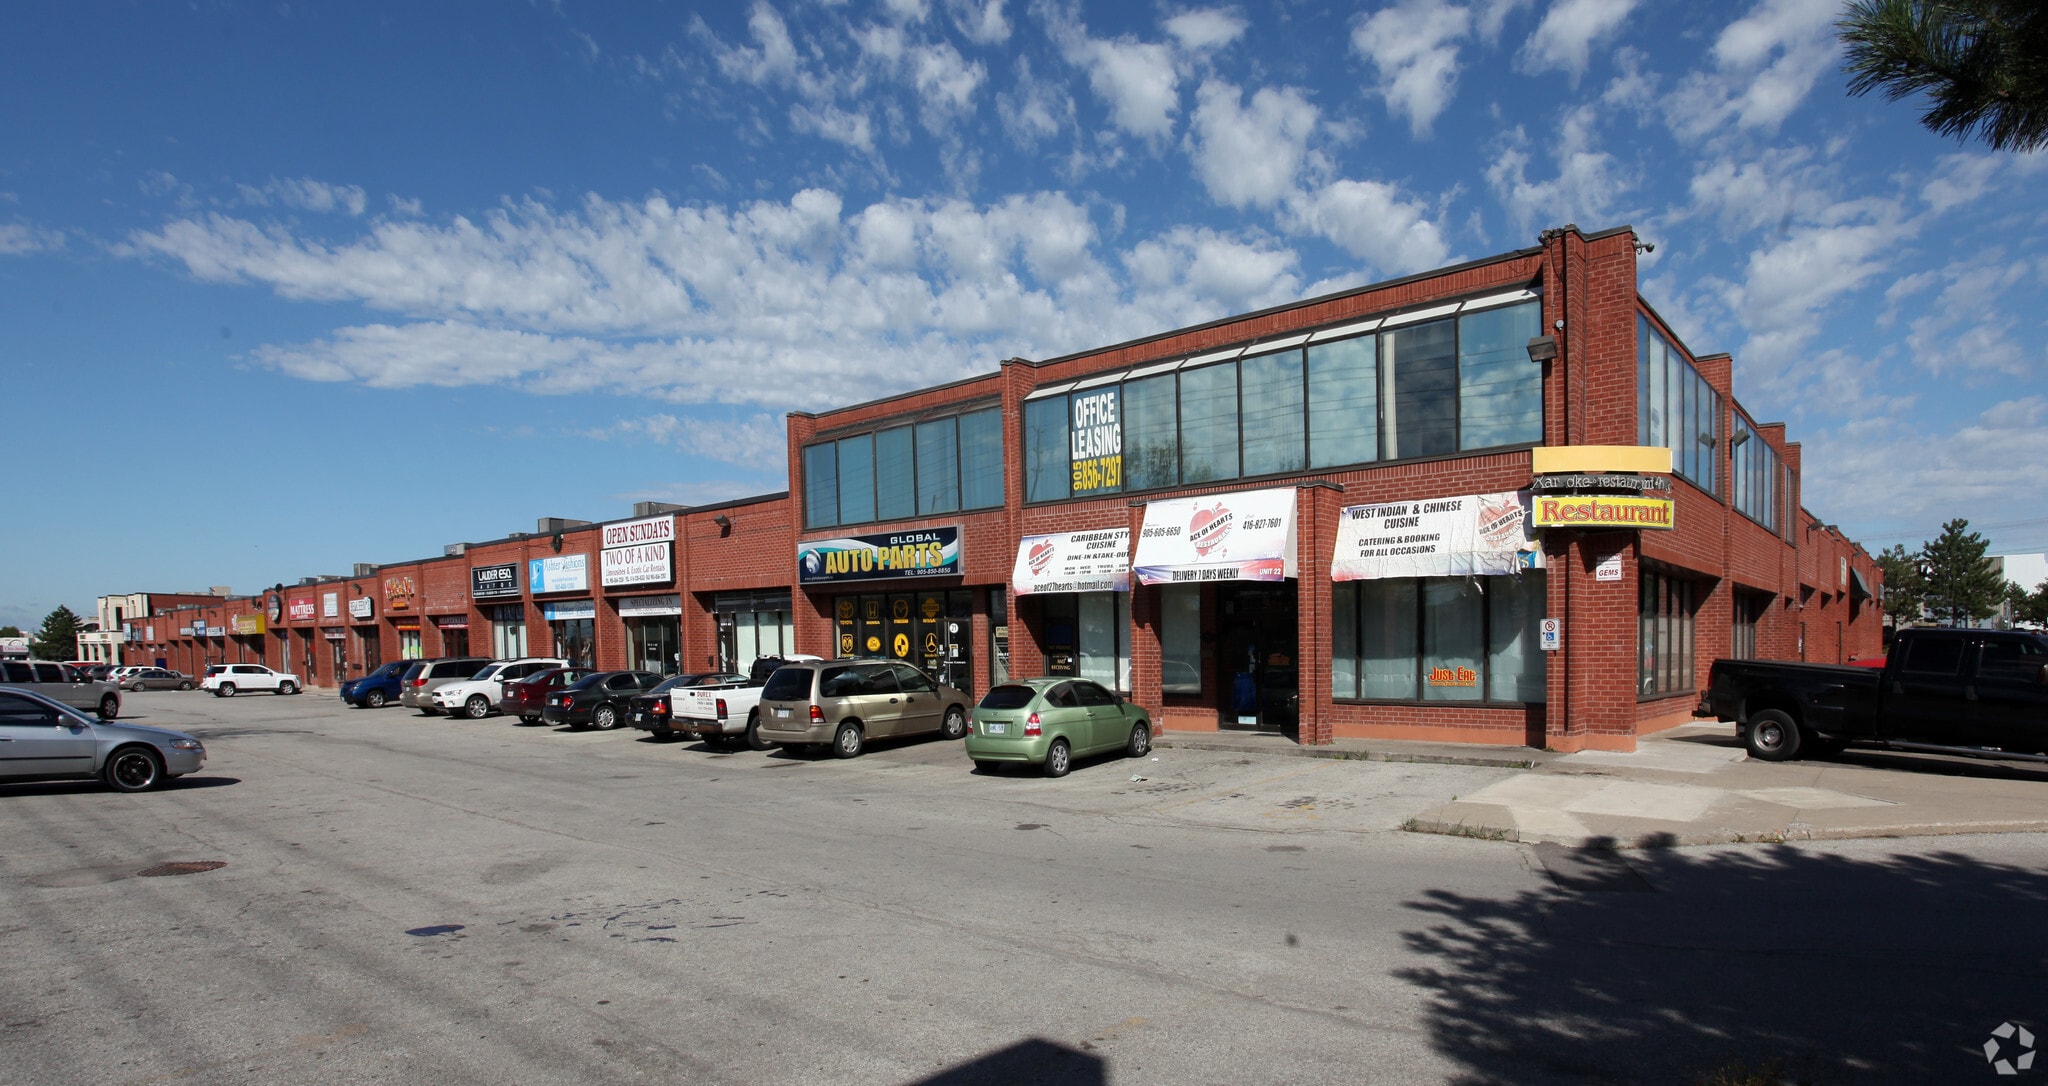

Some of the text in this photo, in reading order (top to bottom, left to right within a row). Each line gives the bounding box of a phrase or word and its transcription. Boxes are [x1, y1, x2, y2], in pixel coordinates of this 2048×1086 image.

[1075, 392, 1115, 428] OFFICE
[1072, 423, 1121, 460] LEASING
[1073, 455, 1121, 490] 905 856-7297
[1352, 500, 1462, 519] WEST INDIAN & CHINESE
[1541, 500, 1669, 524] Restaurant
[1190, 513, 1233, 542] ACE OF HEARTS
[1243, 518, 1281, 530] 416-827-7601
[1384, 516, 1419, 530] CUISINE
[1480, 510, 1523, 535] ACE OF HEARTS
[606, 520, 670, 545] OPEN SUNDAYS
[890, 533, 941, 544] GLOBAL
[1071, 534, 1113, 543] CARIBBEAN
[1142, 526, 1182, 538] 905-605-6650
[1086, 540, 1117, 550] CUISINE
[1358, 537, 1396, 547] CATERING
[1404, 533, 1440, 543] BOOKING
[605, 545, 665, 567] TWO OF A KIND
[825, 541, 944, 574] AUTO PARTS
[1066, 553, 1091, 561] DINE-IN
[1360, 545, 1436, 558] FOR ALL OCCASIONS
[477, 569, 498, 581] LAUDER
[1173, 569, 1198, 581] DELIVERY
[1202, 568, 1217, 580] DAYS
[1217, 567, 1240, 579] WEEKLY
[1259, 568, 1273, 576] UNIT
[1598, 569, 1619, 577] GEMS
[480, 582, 512, 590] AUTOS
[290, 605, 315, 614] MATTRESS
